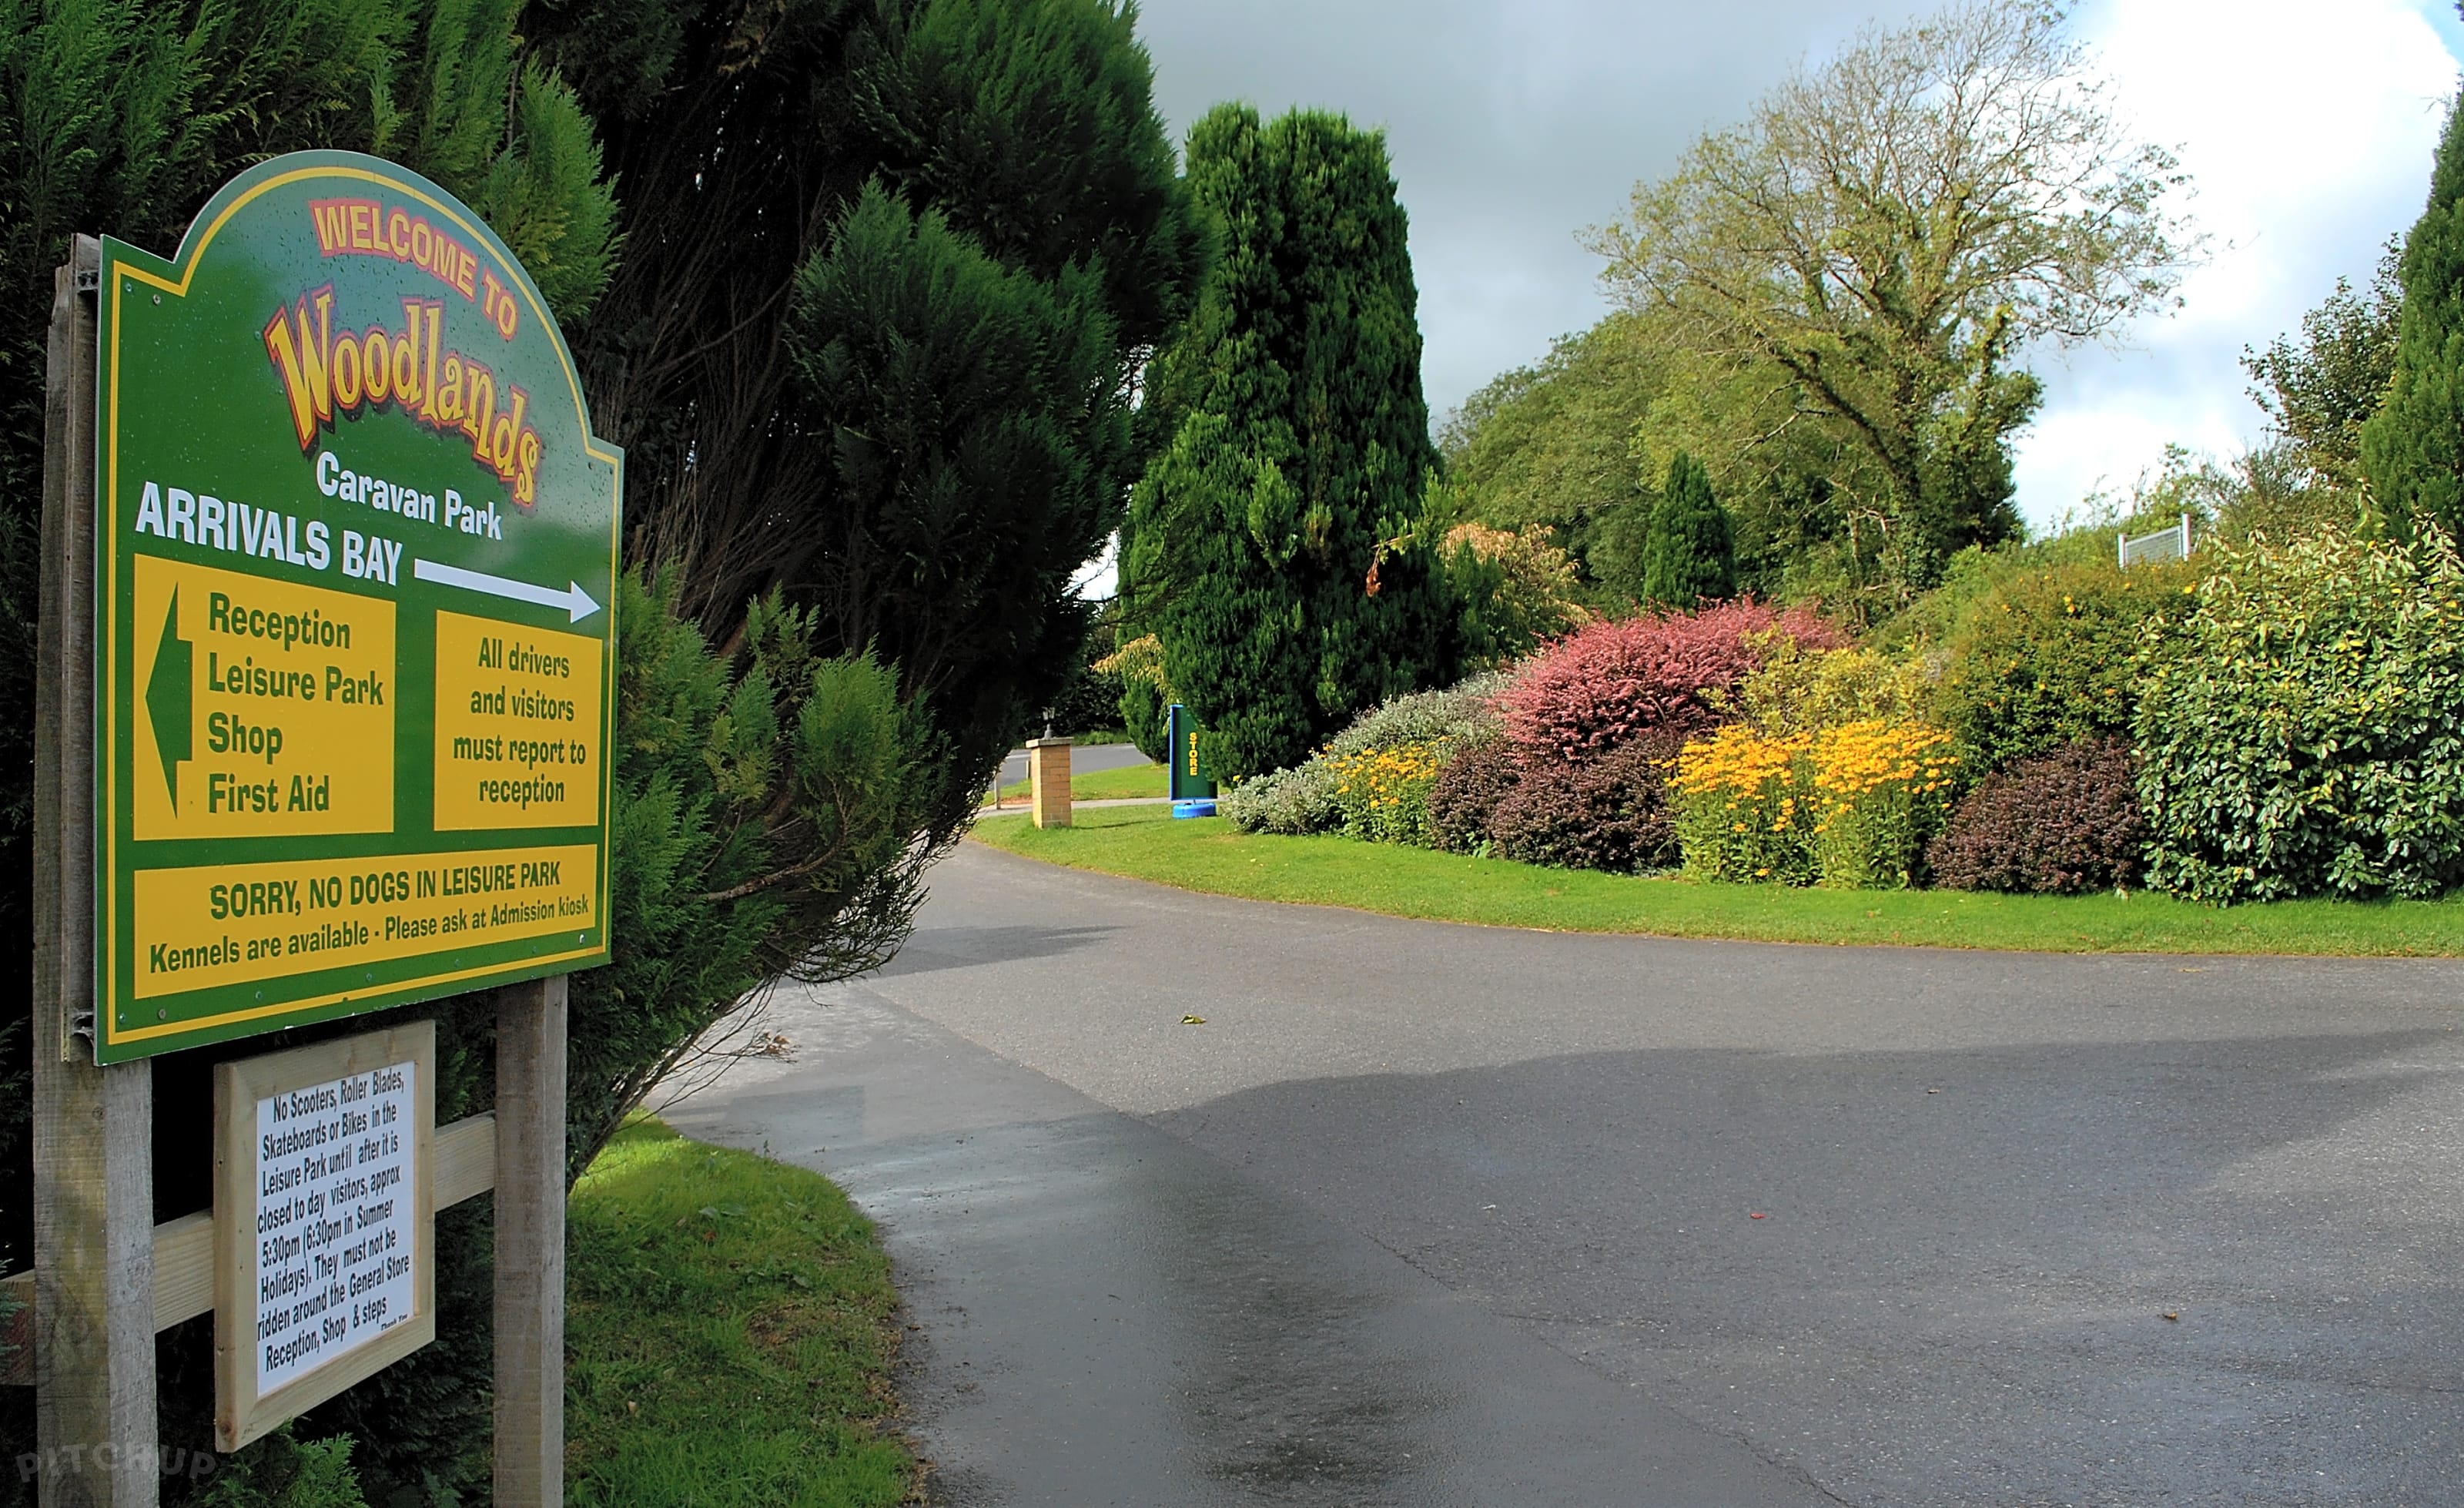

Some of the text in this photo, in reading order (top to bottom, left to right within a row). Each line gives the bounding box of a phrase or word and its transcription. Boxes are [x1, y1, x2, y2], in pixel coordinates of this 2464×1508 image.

[312, 200, 519, 340] WELCOME TO
[263, 282, 540, 509] Woodlands
[316, 451, 502, 540] Caravan Park
[136, 481, 402, 587] ARRIVALS BAY
[209, 592, 351, 651] Reception
[209, 652, 384, 706] Leisure Park
[477, 637, 570, 679] All drivers
[470, 685, 574, 722] and visitors
[208, 712, 283, 764] Shop
[454, 734, 586, 770] must report to
[1189, 732, 1198, 776] STORE
[209, 773, 330, 813] First Aid
[479, 773, 564, 810] reception
[210, 861, 560, 921] SORRY, NO DOGS IN LEISURE PARK
[149, 935, 239, 973] Kennels
[247, 936, 282, 961] are
[288, 920, 368, 954] available
[384, 917, 437, 941] Please
[442, 907, 467, 932] ask
[472, 910, 487, 929] at
[490, 900, 554, 927] Admission
[558, 893, 589, 917] kiosk
[273, 1068, 404, 1123] No Scooters, Roller Blades,
[263, 1101, 397, 1161] Skateboards or Bikes in the
[263, 1131, 398, 1197] Leisure Park until after it is
[257, 1165, 400, 1234] closed to day visitors, approx
[263, 1198, 393, 1268] 5:30pm (6:30pm in Summer
[261, 1226, 397, 1304] Holidays). They must not be
[257, 1255, 410, 1342] ridden around the General Store
[266, 1295, 387, 1372] Reception, Shop & steps
